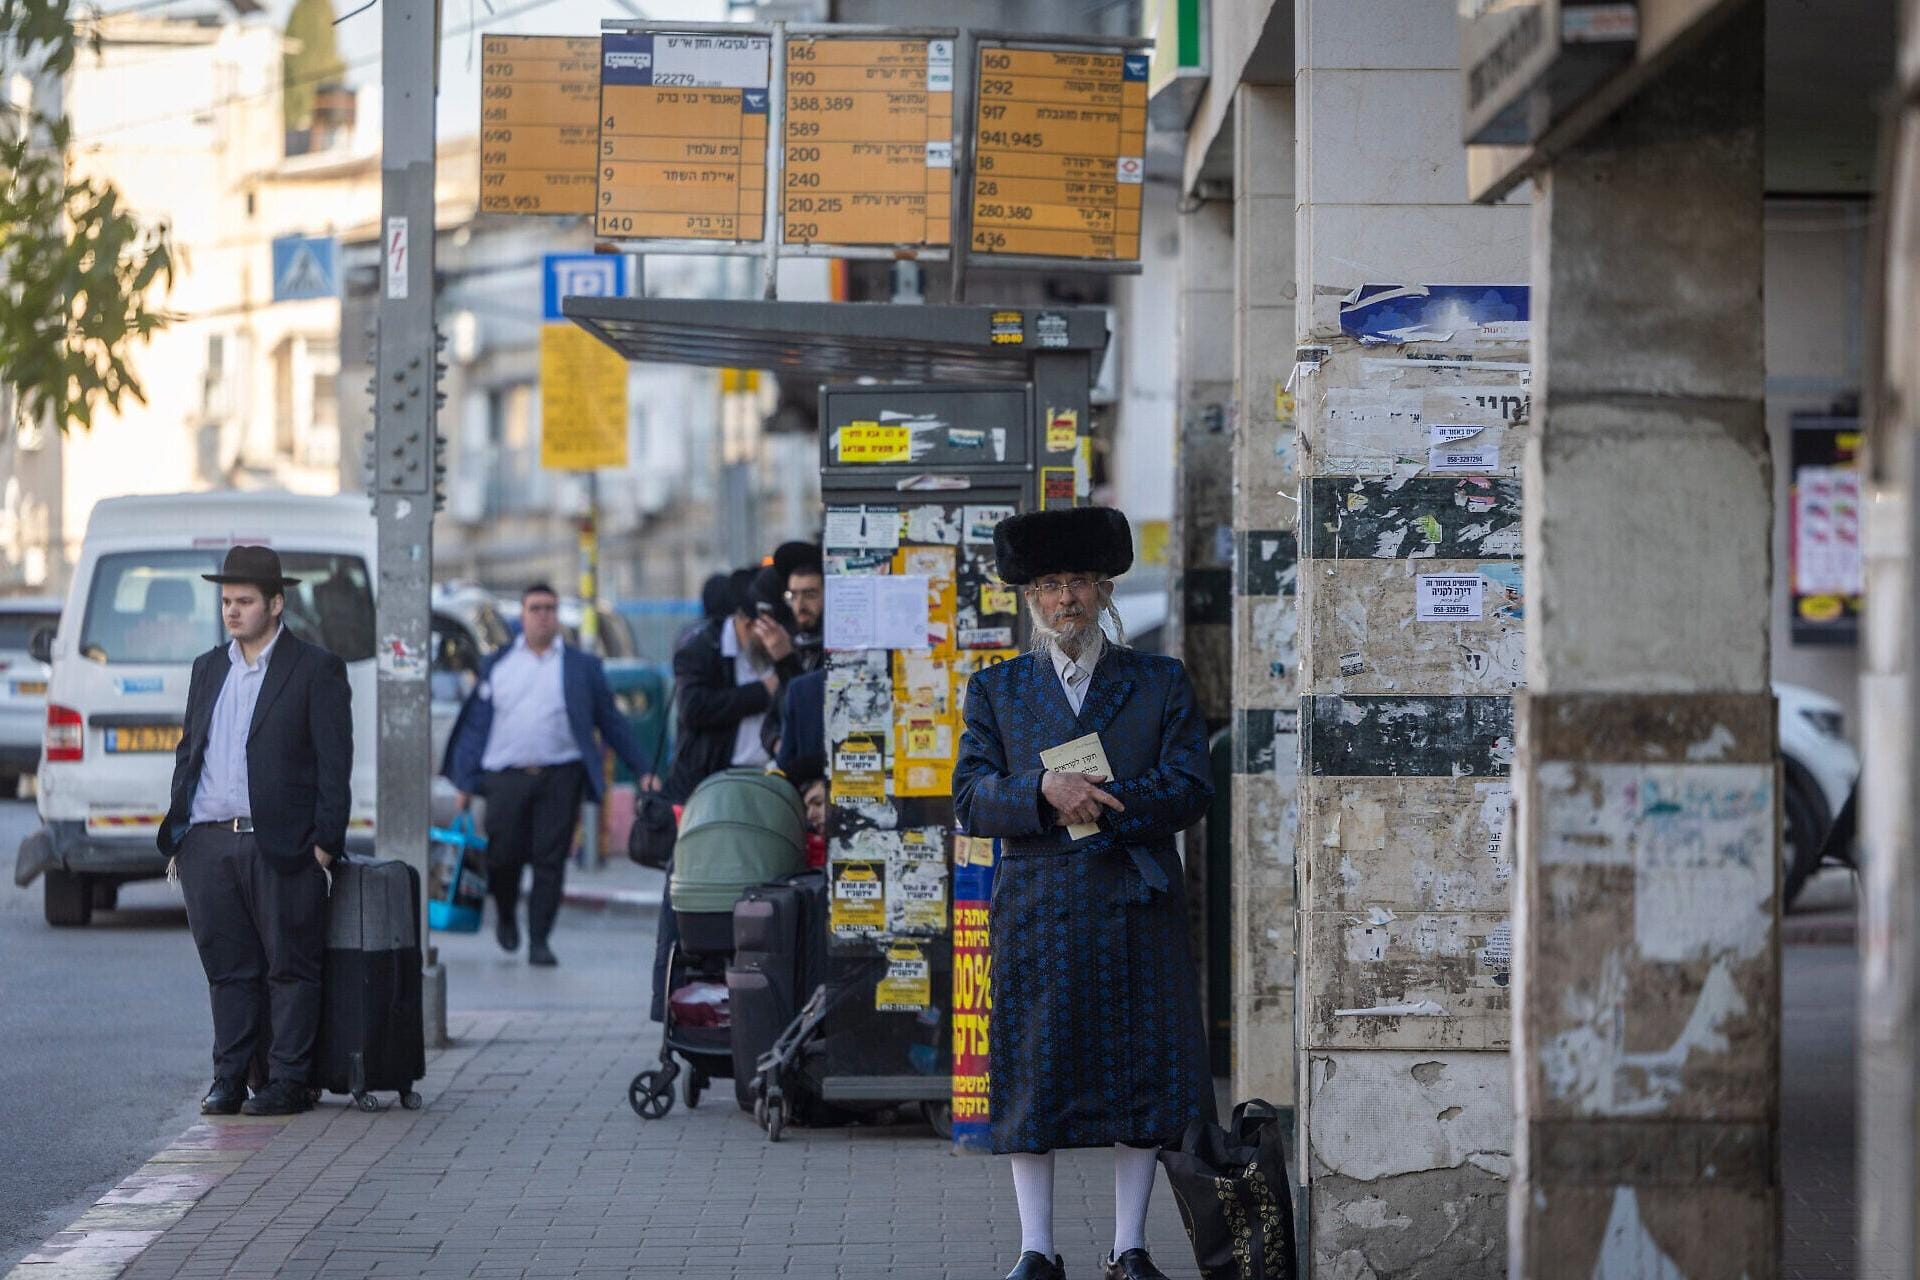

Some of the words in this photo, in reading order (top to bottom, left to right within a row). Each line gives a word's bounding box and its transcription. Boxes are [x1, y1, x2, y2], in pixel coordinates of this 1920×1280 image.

[790, 47, 816, 61] 146
[985, 55, 1011, 69] 160
[654, 73, 695, 85] 22279
[790, 72, 816, 85] 190
[983, 80, 1013, 95] 292
[656, 93, 678, 104] ברק
[682, 93, 698, 103] בני
[789, 97, 854, 114] 388,389
[982, 106, 1006, 120] 917
[604, 116, 615, 129] 4
[789, 123, 820, 136] 589
[981, 130, 1043, 148] 941,945
[603, 142, 614, 155] 5
[719, 145, 740, 155] בית
[788, 148, 820, 161] 200
[979, 157, 994, 170] 18
[604, 168, 614, 181] 9
[662, 170, 697, 182] השחר
[702, 171, 735, 182] איילת
[788, 173, 820, 187] 240
[977, 182, 998, 196] 28
[602, 192, 612, 205] 9
[788, 198, 842, 215] 210,215
[978, 204, 1032, 221] 280,380
[1078, 208, 1111, 220] אלעד
[601, 217, 633, 231] 140
[687, 217, 711, 228] ברק
[716, 218, 734, 228] בני
[788, 224, 818, 237] 220
[975, 232, 1006, 247] 436
[1432, 586, 1453, 597] לקניה
[1454, 588, 1471, 596] דירה
[965, 931, 989, 947] היות
[954, 1014, 990, 1065] צדק
